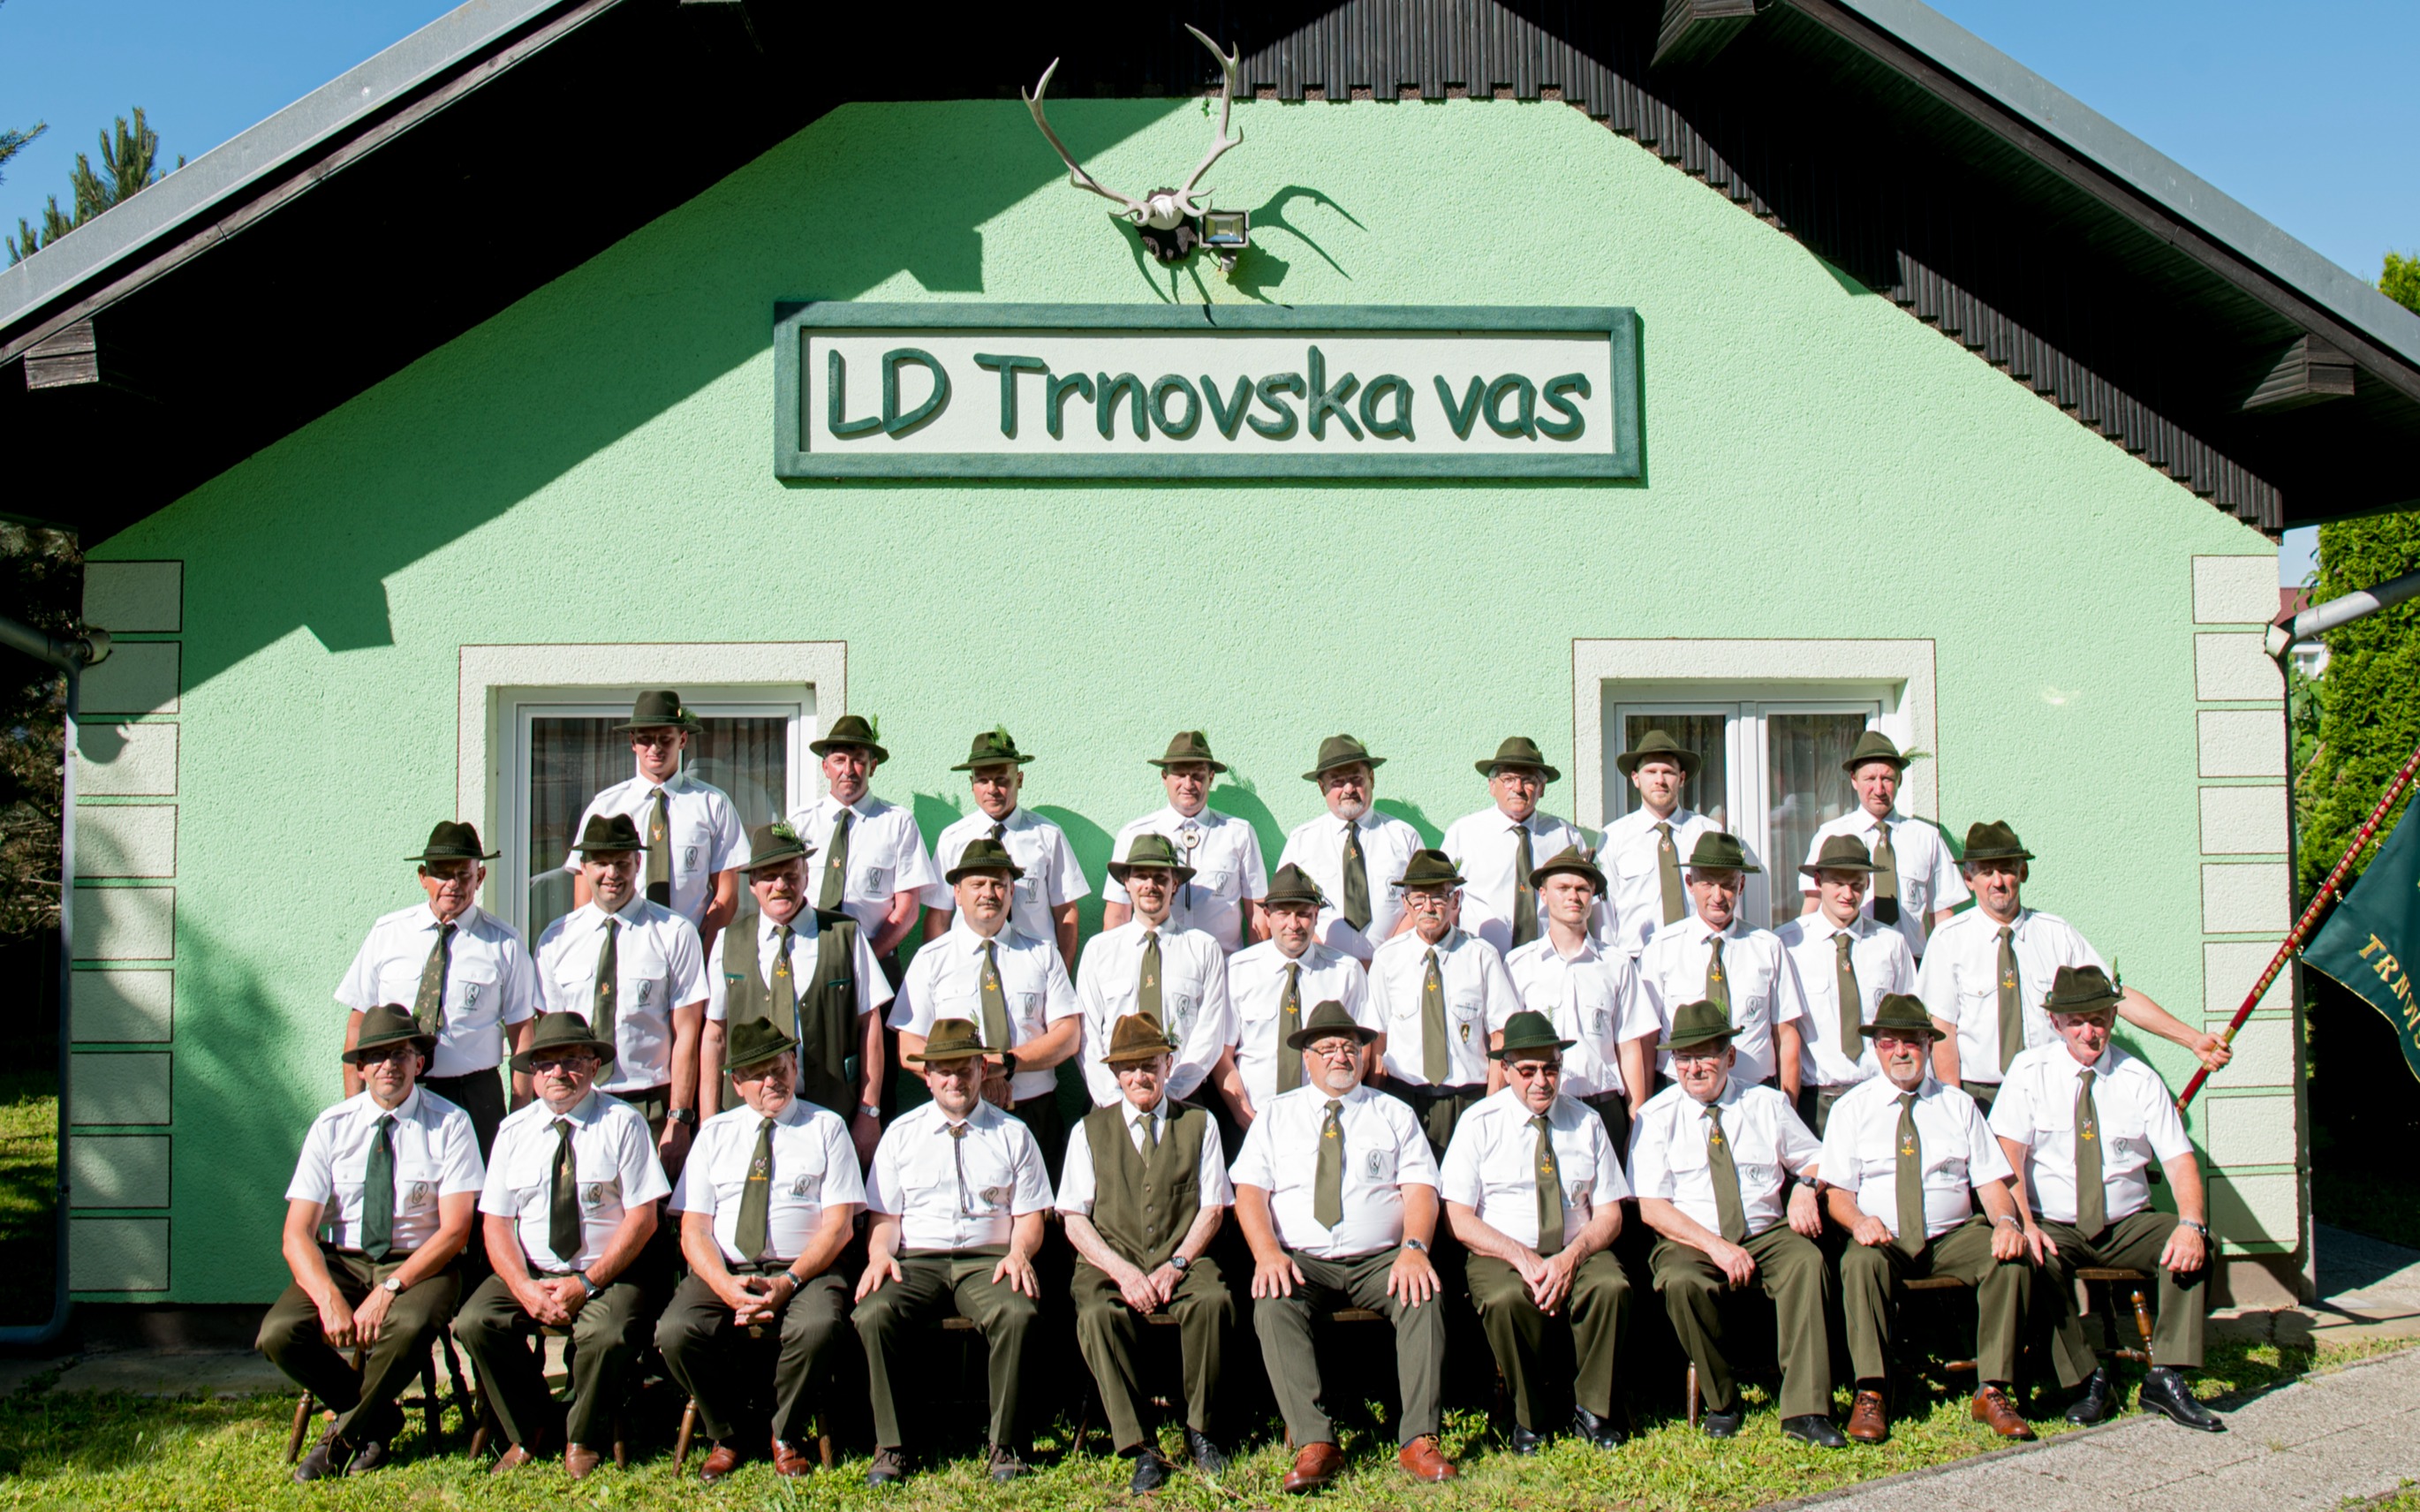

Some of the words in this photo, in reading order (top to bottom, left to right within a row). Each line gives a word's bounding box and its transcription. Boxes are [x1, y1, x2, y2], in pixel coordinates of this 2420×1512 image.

[828, 347, 951, 438] LD
[973, 345, 1416, 441] Trnovska
[1433, 373, 1592, 441] vas
